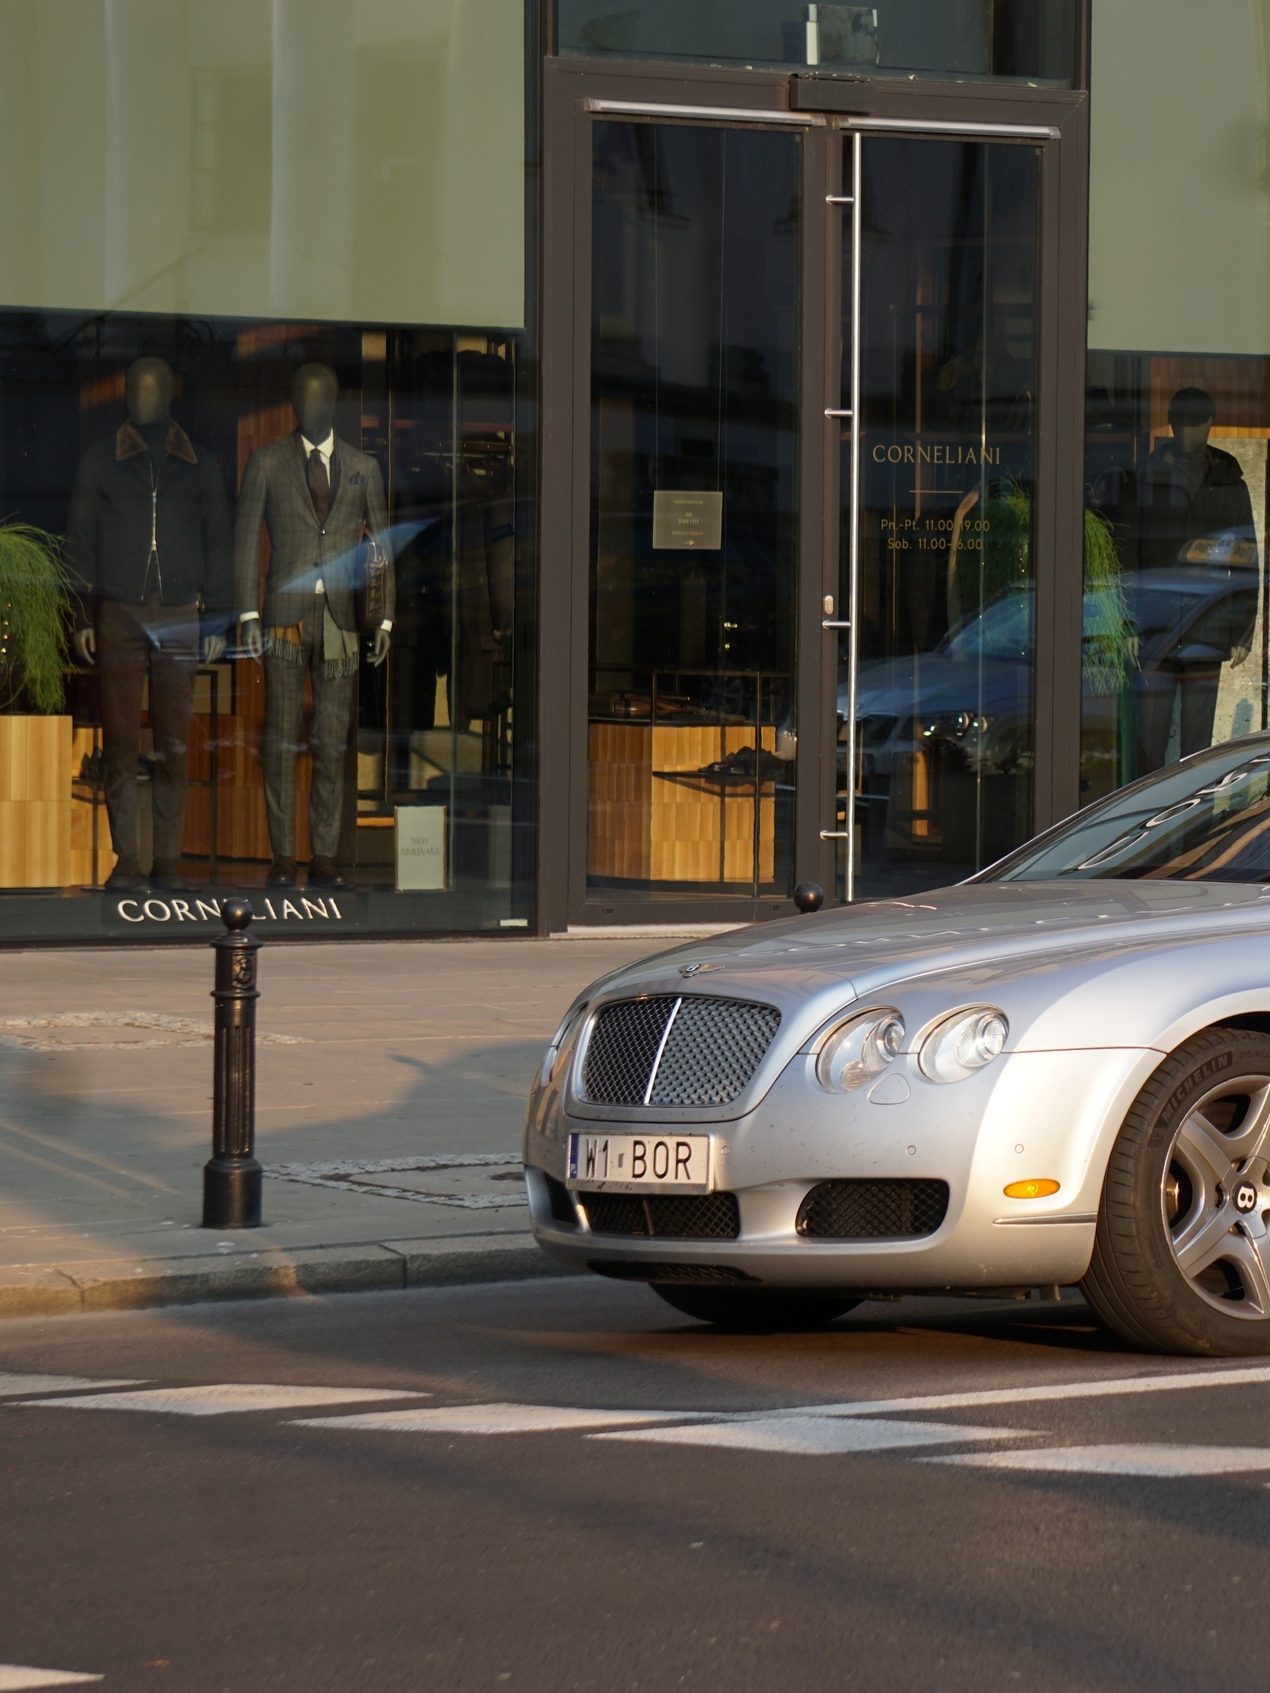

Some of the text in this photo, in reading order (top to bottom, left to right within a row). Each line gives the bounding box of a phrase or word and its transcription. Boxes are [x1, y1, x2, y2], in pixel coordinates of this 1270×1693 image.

[872, 444, 1000, 465] CORNELIANI
[925, 519, 990, 532] 11.0019.00
[887, 537, 983, 550] Sob. 11.00-6.00
[411, 837, 429, 846] NEW
[117, 898, 342, 922] CORNLIANI
[1161, 1053, 1229, 1123] MICHELIN
[586, 1138, 693, 1181] W1 BOR
